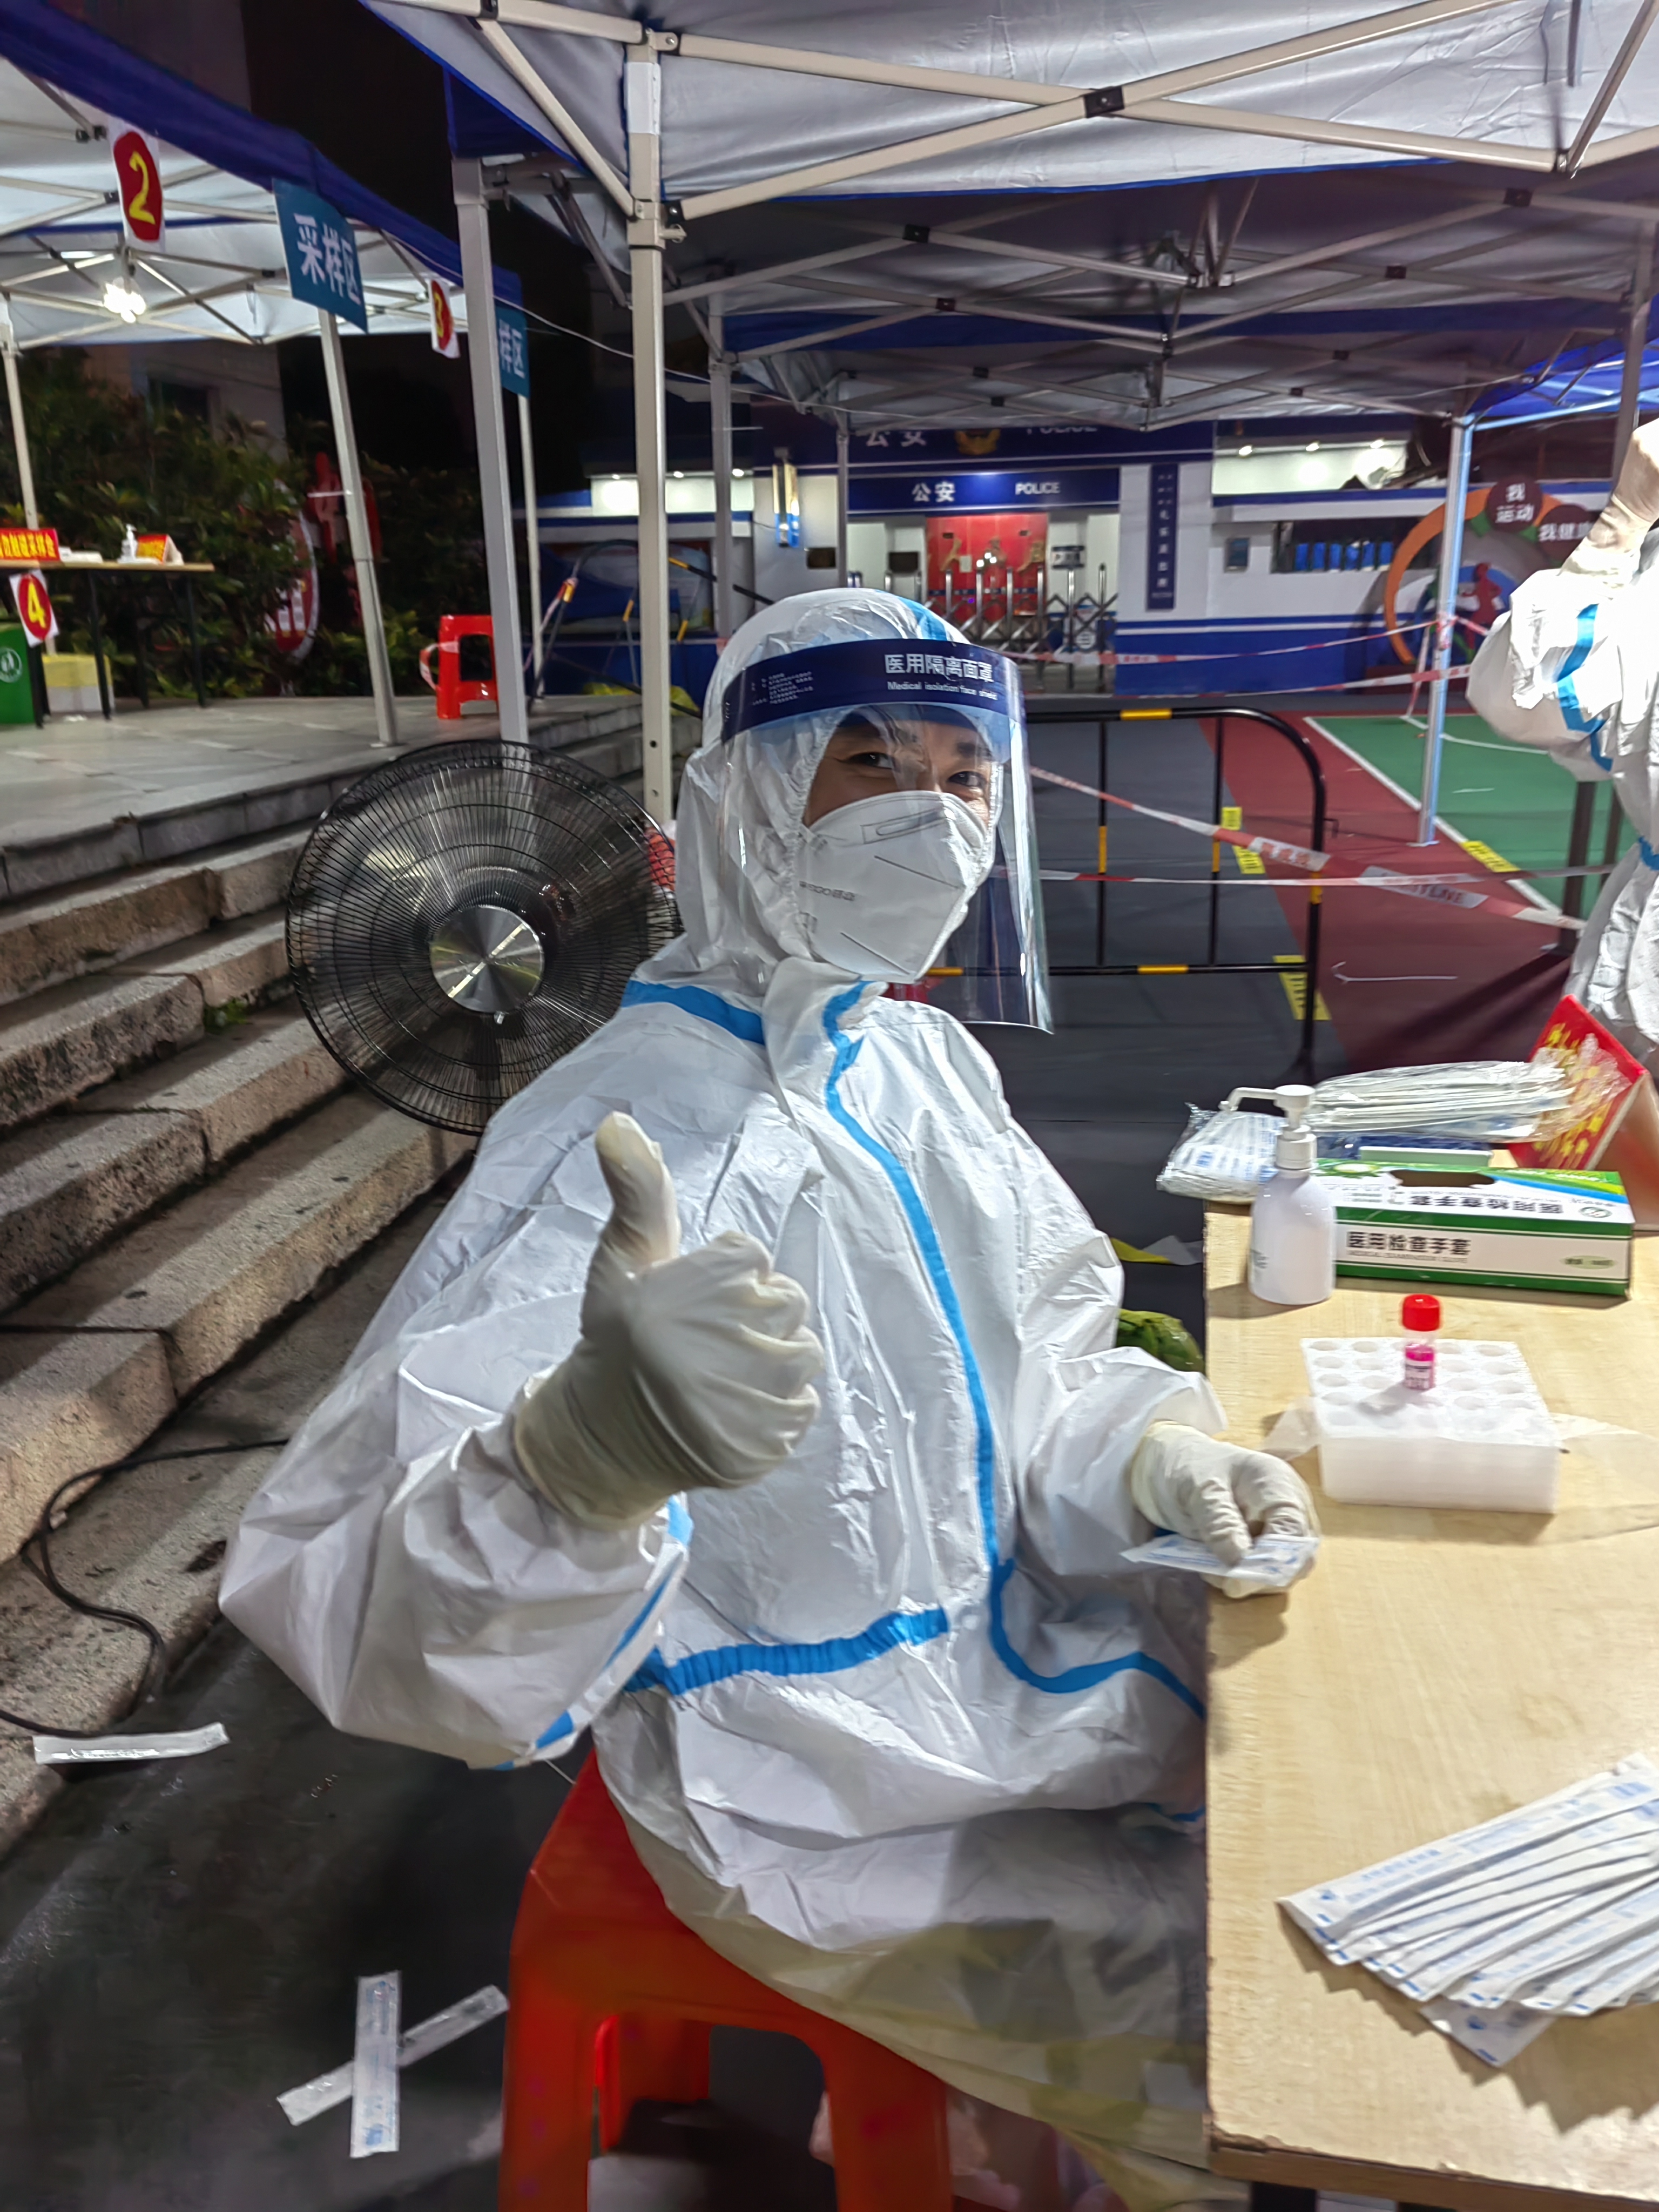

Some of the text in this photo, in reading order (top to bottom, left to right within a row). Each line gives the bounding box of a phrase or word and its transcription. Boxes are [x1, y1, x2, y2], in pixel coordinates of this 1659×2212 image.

[129, 151, 156, 225] 2
[294, 213, 361, 305] 采样区
[912, 482, 1060, 502] 公安 POLICE
[28, 582, 46, 629] 4
[885, 653, 994, 683] 医用隔离面罩
[887, 682, 922, 690] Medical
[960, 685, 976, 695] face
[1347, 1231, 1471, 1255] 医用检查手套
